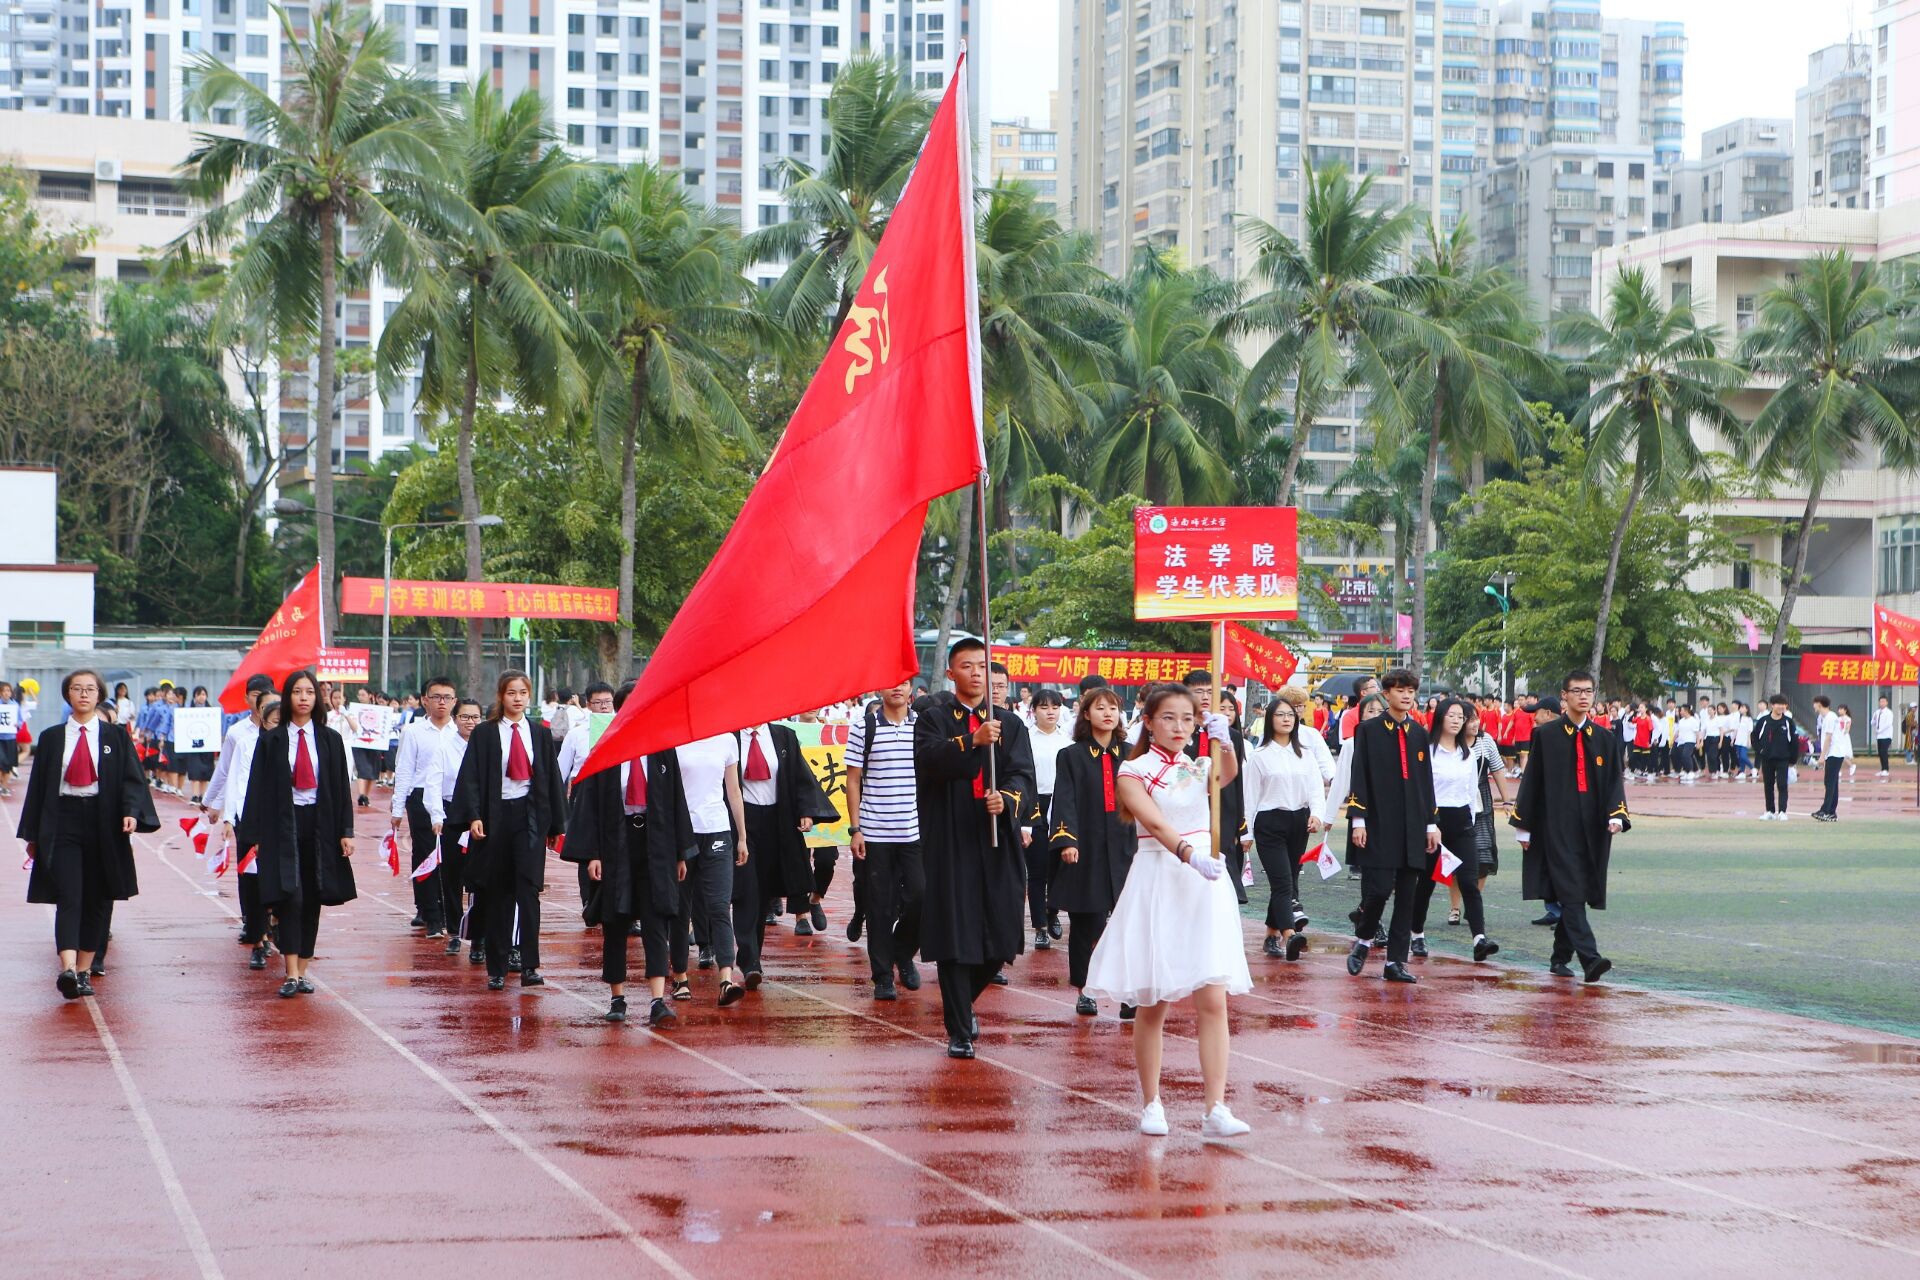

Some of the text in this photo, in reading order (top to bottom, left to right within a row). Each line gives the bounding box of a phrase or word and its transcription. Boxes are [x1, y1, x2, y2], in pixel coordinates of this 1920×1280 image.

[1164, 543, 1275, 568] 法学院
[368, 585, 486, 611] 严守军训纪律
[1156, 573, 1283, 599] 学生代表队
[1098, 656, 1229, 681] 健康幸福生活一
